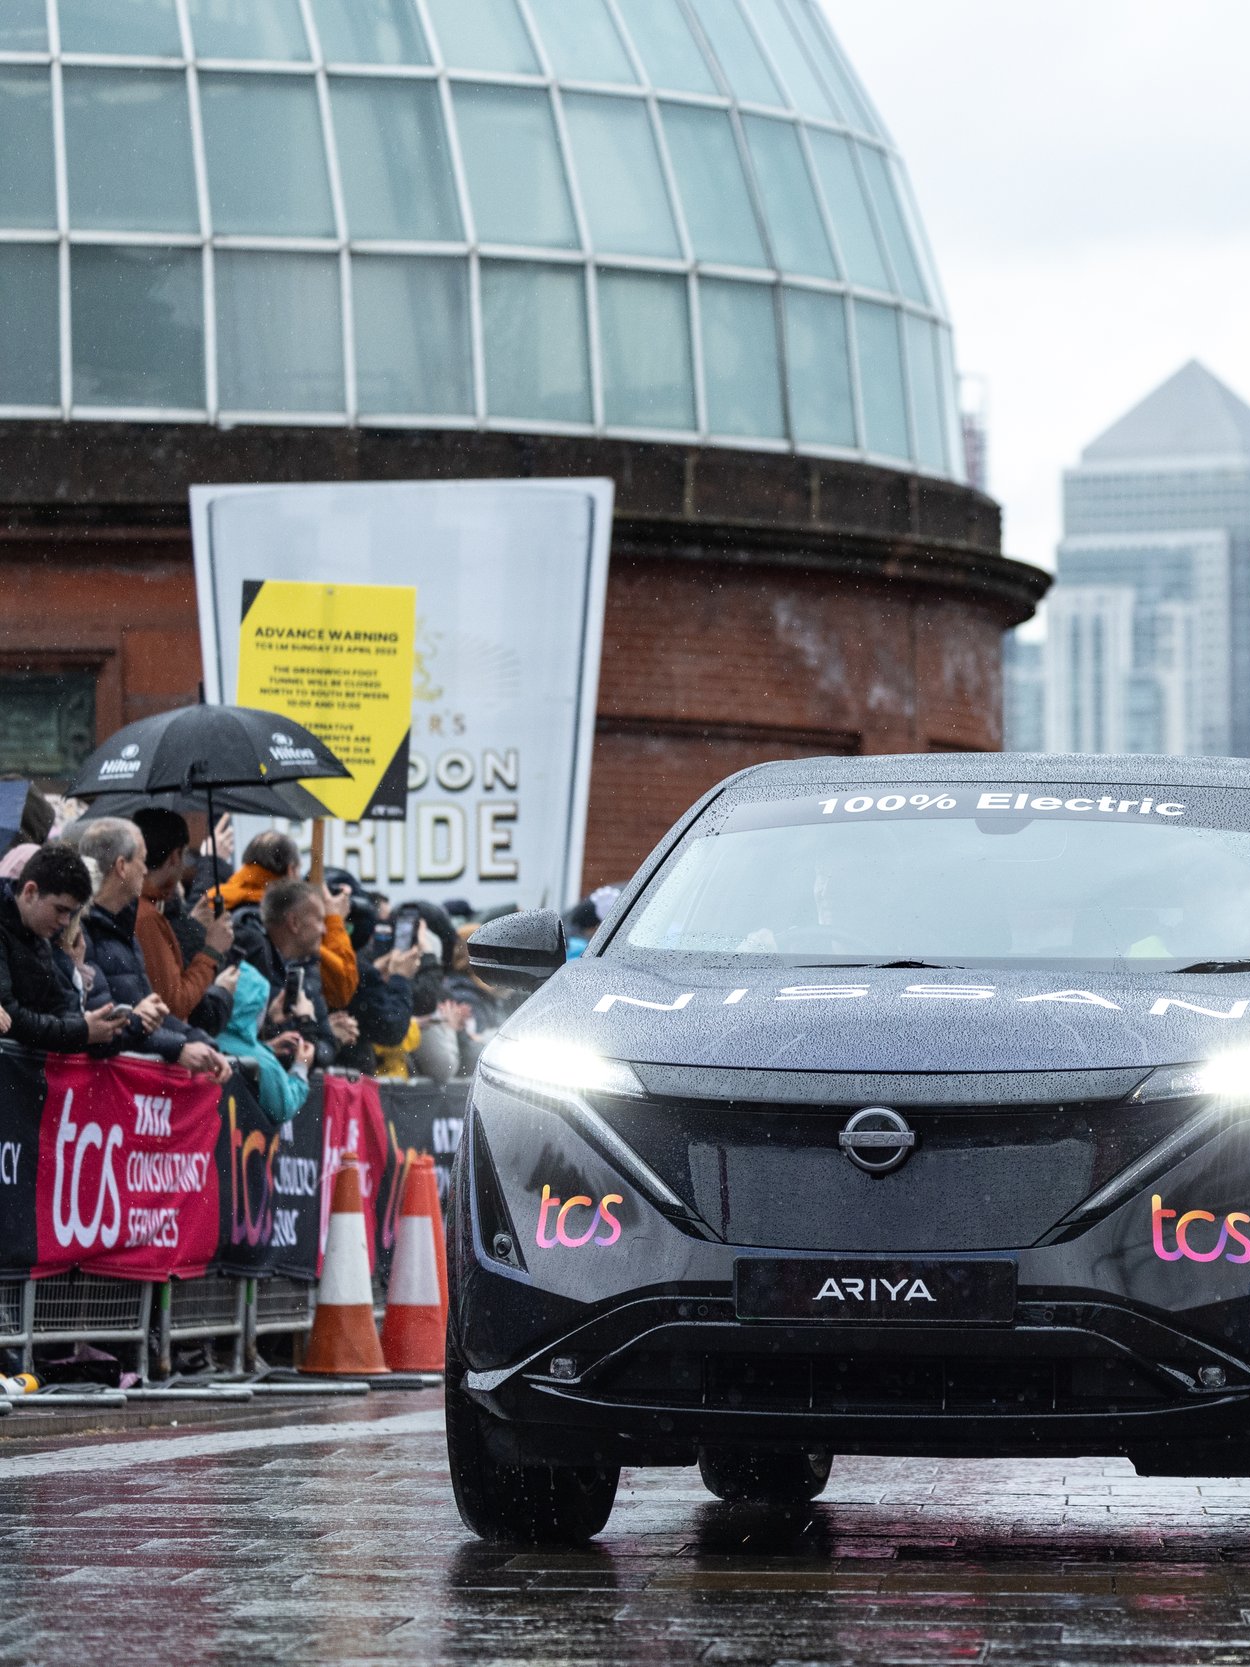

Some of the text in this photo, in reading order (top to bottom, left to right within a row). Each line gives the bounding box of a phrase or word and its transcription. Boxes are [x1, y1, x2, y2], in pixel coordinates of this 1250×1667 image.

[255, 626, 399, 643] ADVANCE WARNING
[346, 646, 371, 655] APRIL
[100, 758, 141, 775] Hilton
[269, 745, 316, 761] Hilton
[408, 749, 518, 793] DON
[818, 792, 1187, 817] 100% Electric
[592, 983, 1250, 1020] NISSAN
[134, 1093, 172, 1137] TATA
[841, 1134, 912, 1145] NISSAN
[53, 1087, 124, 1249] tcs
[126, 1151, 210, 1193] CONSULTANCY
[125, 1206, 180, 1249] SERVICES
[536, 1184, 624, 1249] tcs
[812, 1277, 937, 1302] ARIYA
